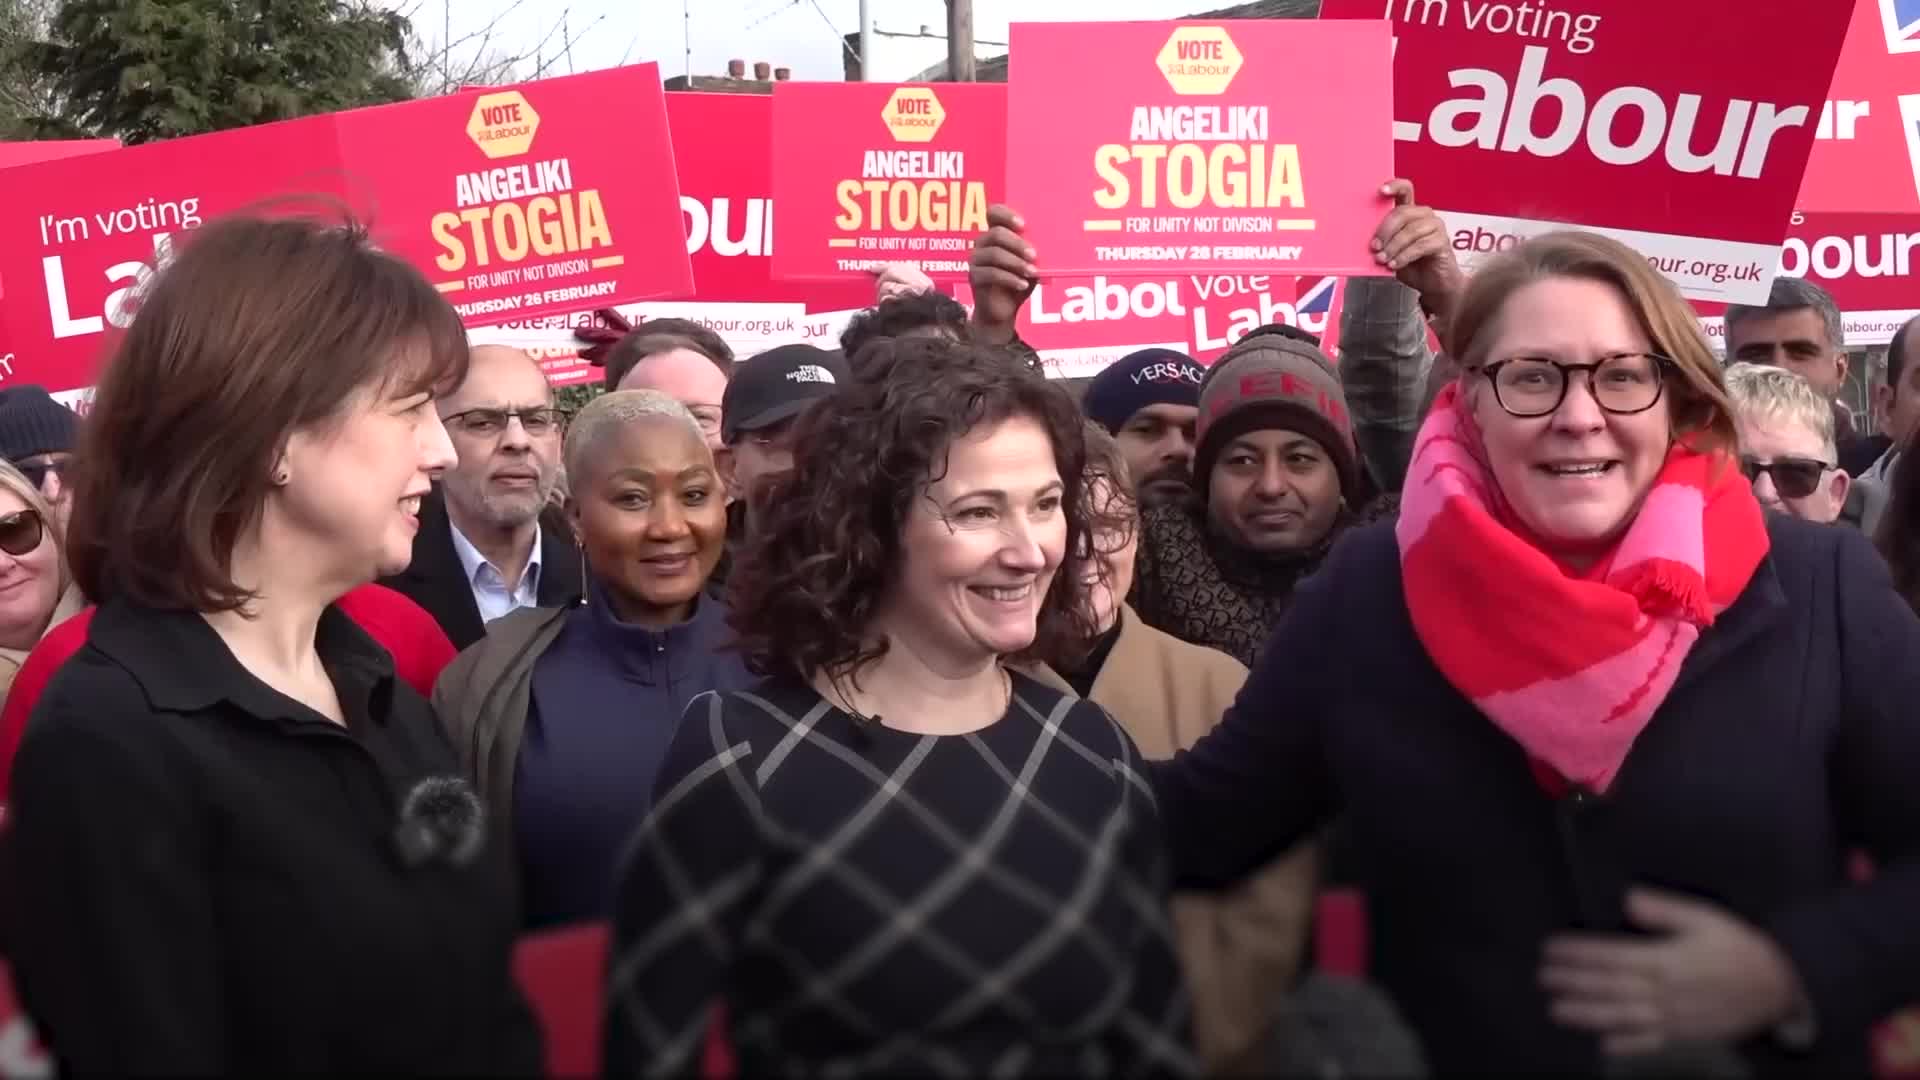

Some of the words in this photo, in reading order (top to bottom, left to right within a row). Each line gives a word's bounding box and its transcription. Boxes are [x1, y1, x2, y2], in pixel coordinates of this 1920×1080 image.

[1463, 0, 1602, 54] voting
[1177, 40, 1223, 60] VOTE
[481, 103, 522, 126] VOTE
[897, 98, 931, 114] VOTE
[487, 125, 530, 140] Labour
[1130, 106, 1269, 141] ANGELIKI
[863, 151, 964, 179] ANGELIKI
[1093, 143, 1305, 209] STOGIA
[455, 158, 573, 207] ANGELIKI
[835, 179, 989, 233] STOGIA
[39, 212, 90, 246] I'm
[96, 196, 203, 237] voting
[431, 189, 614, 272] STOGIA
[1126, 217, 1150, 232] FOR
[1153, 217, 1190, 232] UNITY
[1194, 217, 1220, 232] NOT
[1223, 216, 1273, 232] DIVISON
[859, 237, 878, 249] FOR
[879, 237, 907, 249] UNITY
[909, 237, 927, 249] NOT
[929, 237, 966, 250] DIVISON
[1095, 246, 1188, 261] THURSDAY
[1214, 246, 1303, 260] FEBRUARY
[467, 274, 488, 290] FOR
[490, 269, 521, 287] UNITY
[523, 264, 545, 281] NOT
[546, 258, 589, 277] DIVISON
[922, 260, 970, 272] FEBRUA
[454, 294, 523, 317] HURSDAY
[524, 291, 541, 306] 26
[543, 280, 617, 304] FEBRUARY
[1130, 360, 1203, 386] VERSAC
